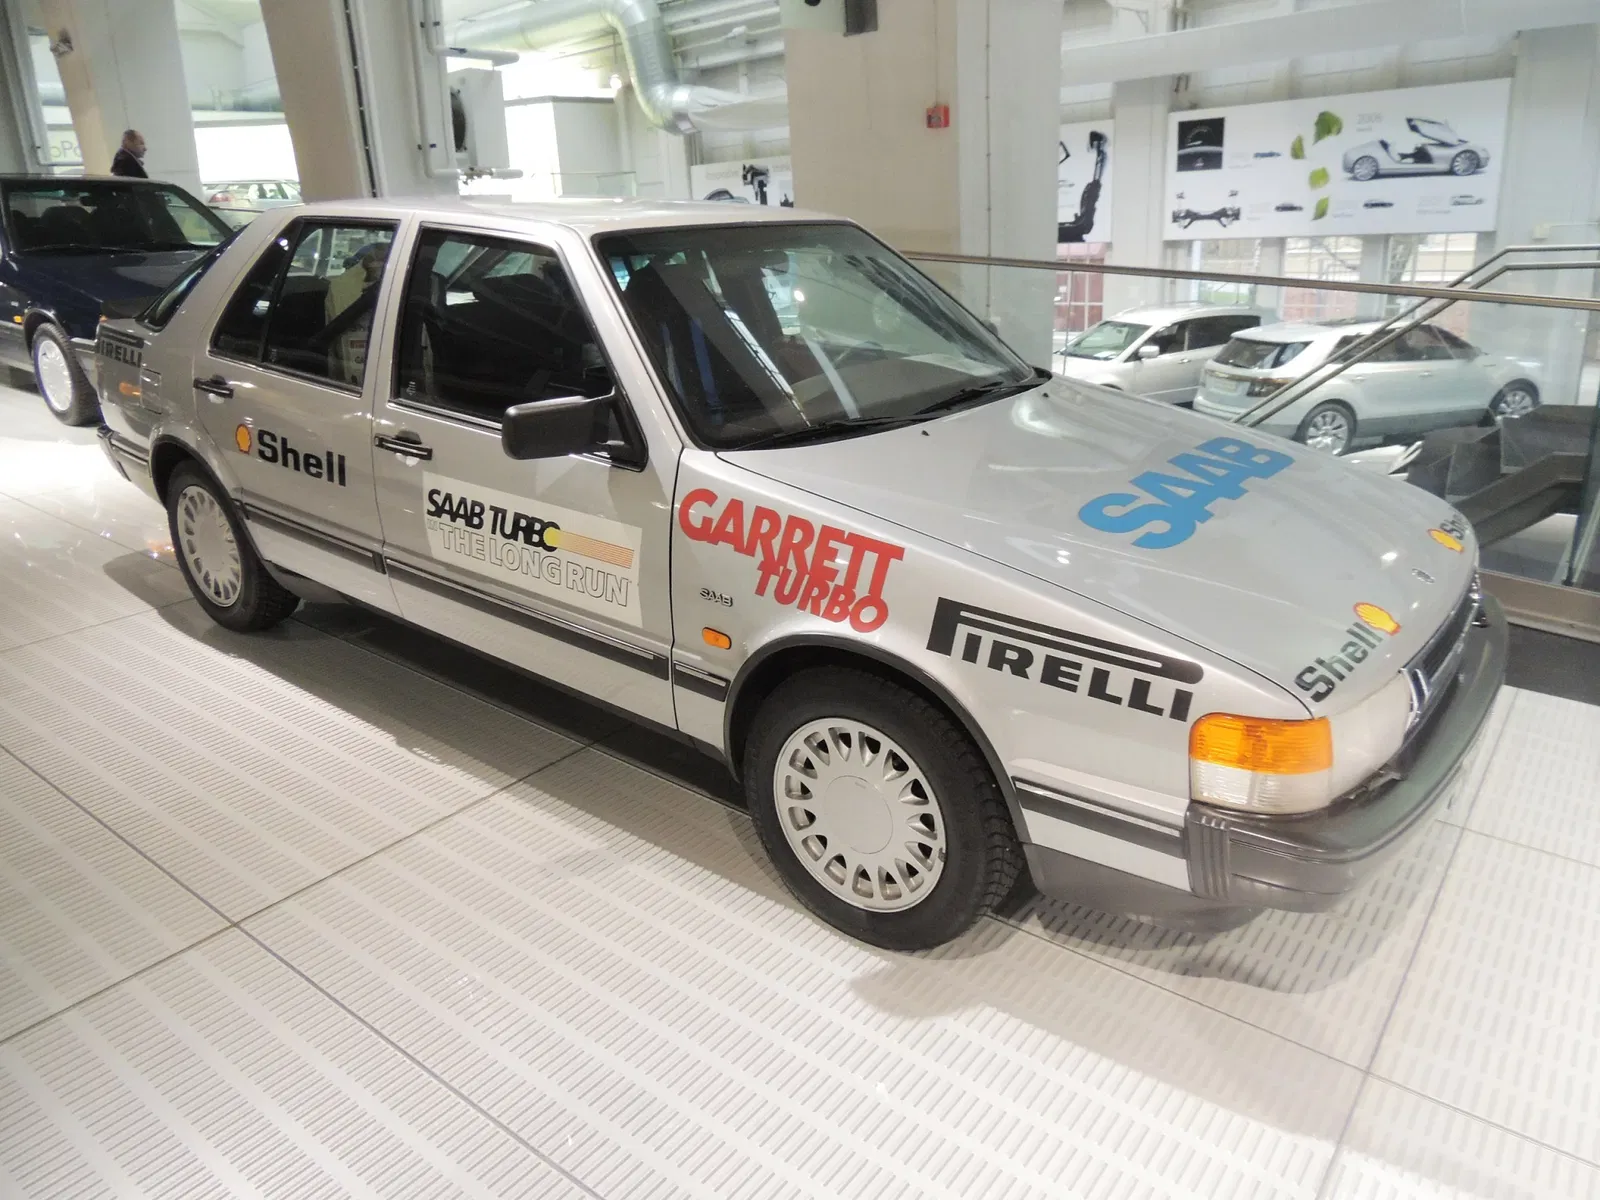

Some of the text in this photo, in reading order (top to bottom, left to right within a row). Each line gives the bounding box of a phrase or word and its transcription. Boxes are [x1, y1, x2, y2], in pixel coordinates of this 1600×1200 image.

[257, 429, 346, 487] Shell
[1078, 436, 1295, 549] SAAB
[426, 488, 485, 530] SAAB
[678, 488, 905, 598] GARRETT
[439, 522, 486, 561] THE
[490, 537, 562, 586] LONG
[566, 560, 630, 607] RUN
[700, 587, 733, 607] SAAB
[754, 561, 889, 633] TURBO
[926, 596, 1204, 722] PIRELLI
[1294, 622, 1384, 703] Shell
